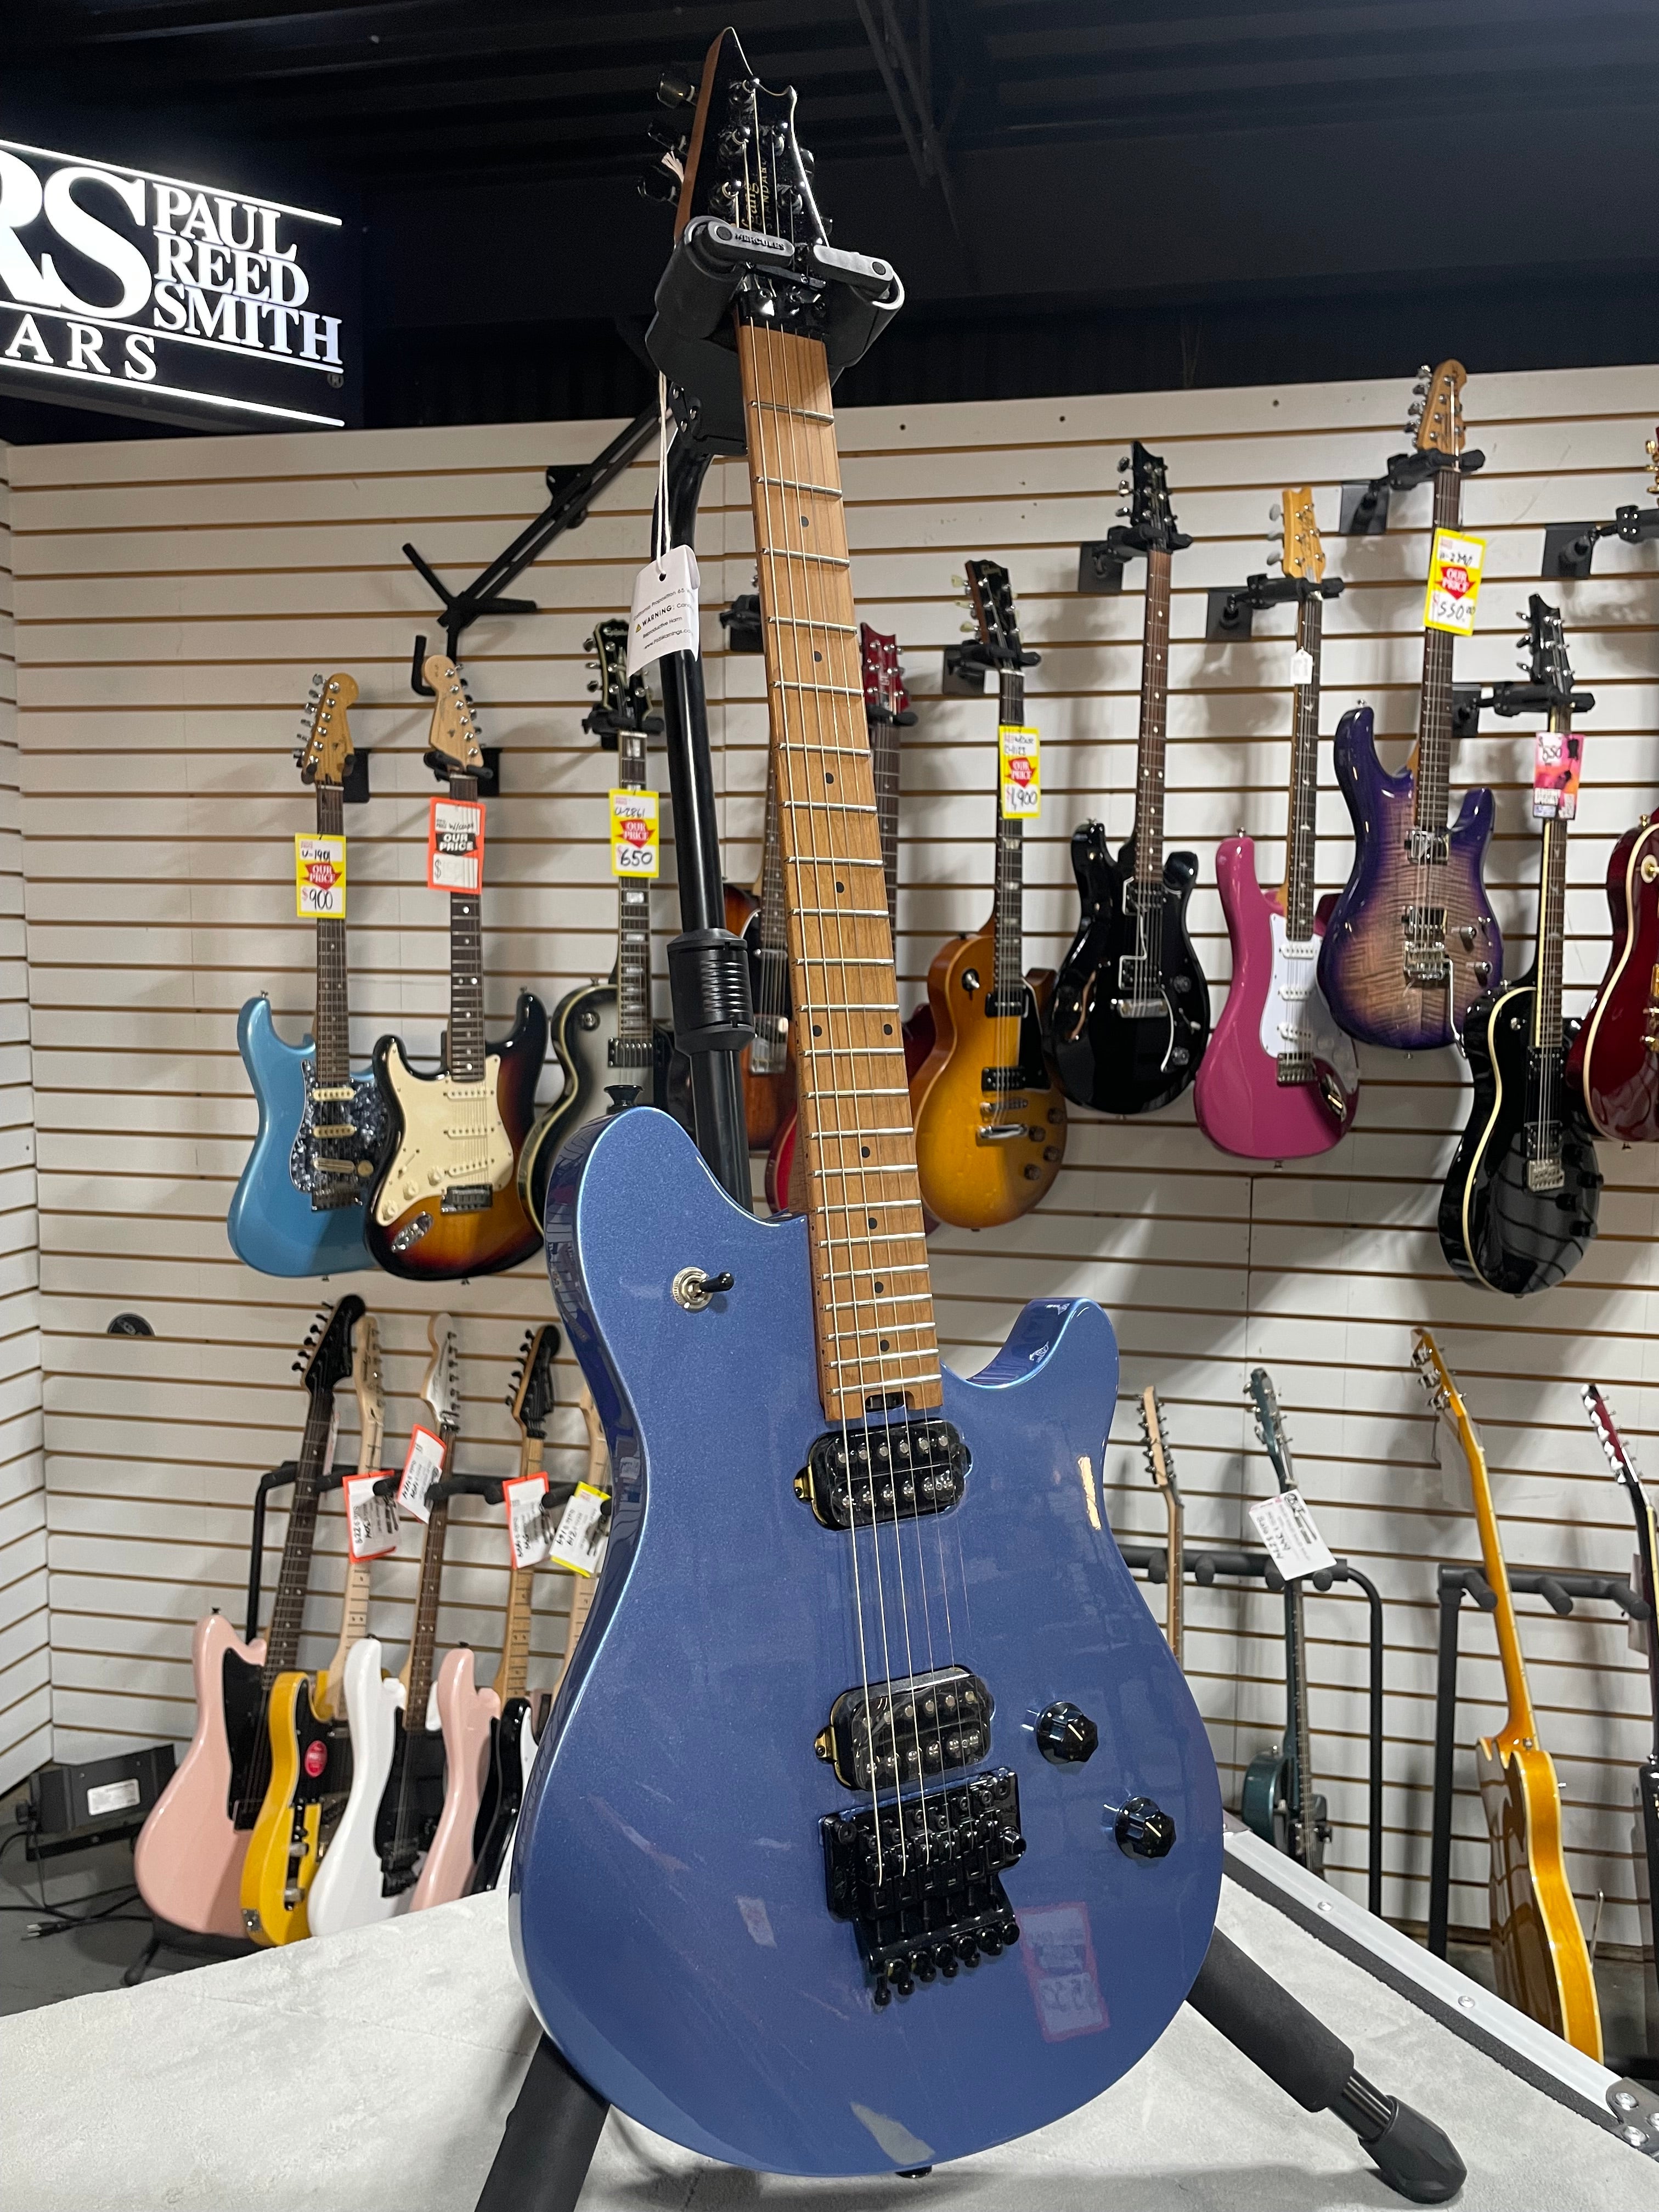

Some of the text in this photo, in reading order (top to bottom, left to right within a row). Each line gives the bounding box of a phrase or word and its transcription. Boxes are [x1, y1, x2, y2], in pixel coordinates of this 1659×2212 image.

[153, 182, 297, 262] PAUL
[735, 233, 785, 251] HERCULES
[153, 231, 309, 308] REED
[154, 283, 343, 365] SMITH
[642, 605, 675, 627] WARNING:
[669, 617, 683, 625] Harm
[625, 821, 646, 831] OUR
[443, 833, 468, 843] OUR
[623, 831, 648, 840] PRICE
[439, 841, 473, 851] PRICE
[312, 864, 332, 874] OUR
[309, 873, 336, 883] PRICE
